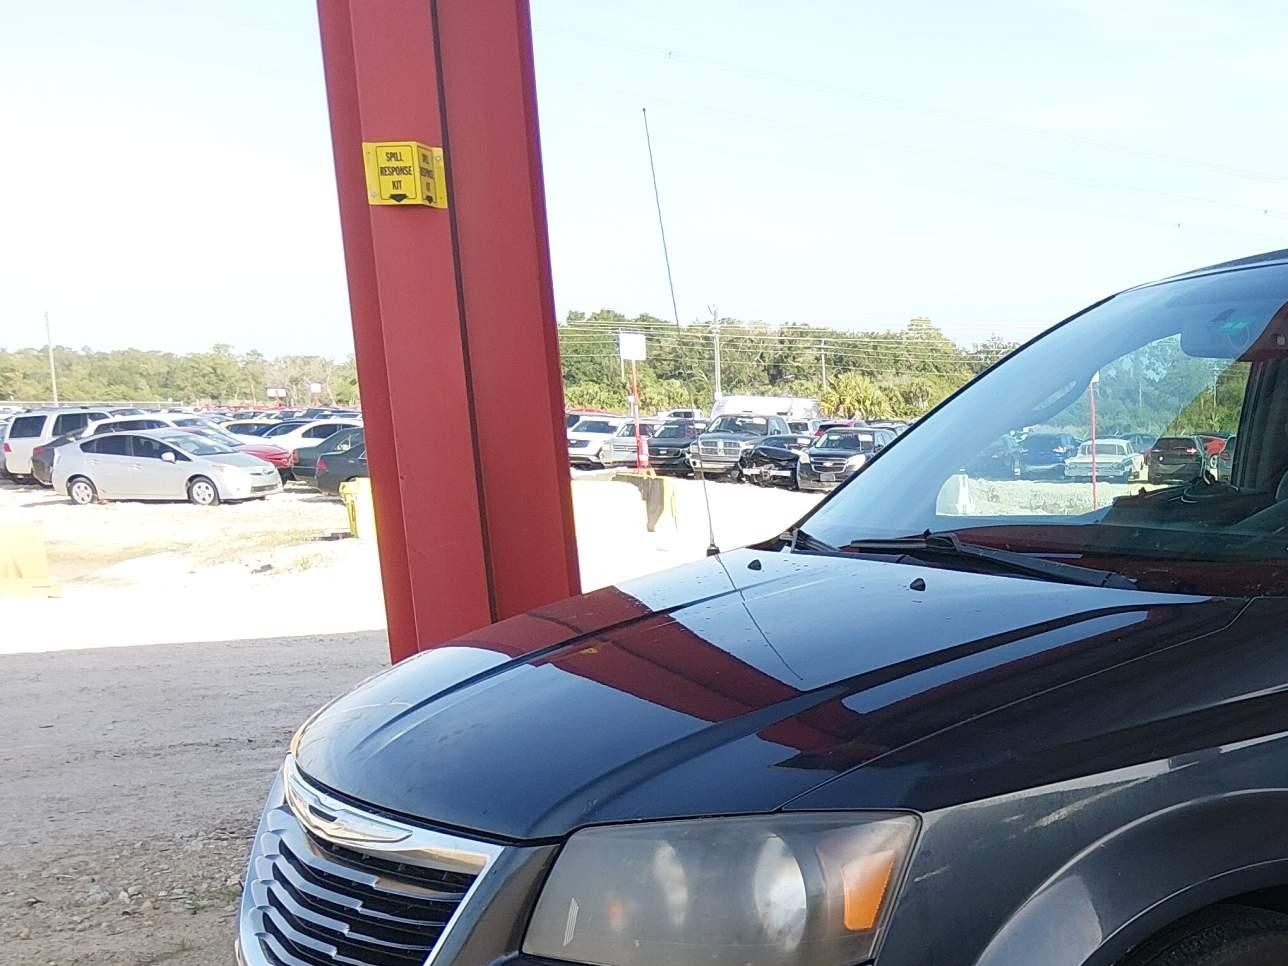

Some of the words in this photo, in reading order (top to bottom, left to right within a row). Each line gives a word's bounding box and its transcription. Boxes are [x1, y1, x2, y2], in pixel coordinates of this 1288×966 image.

[385, 151, 404, 162] SPILL
[380, 165, 413, 177] RESPONSE
[392, 180, 403, 190] KIT
